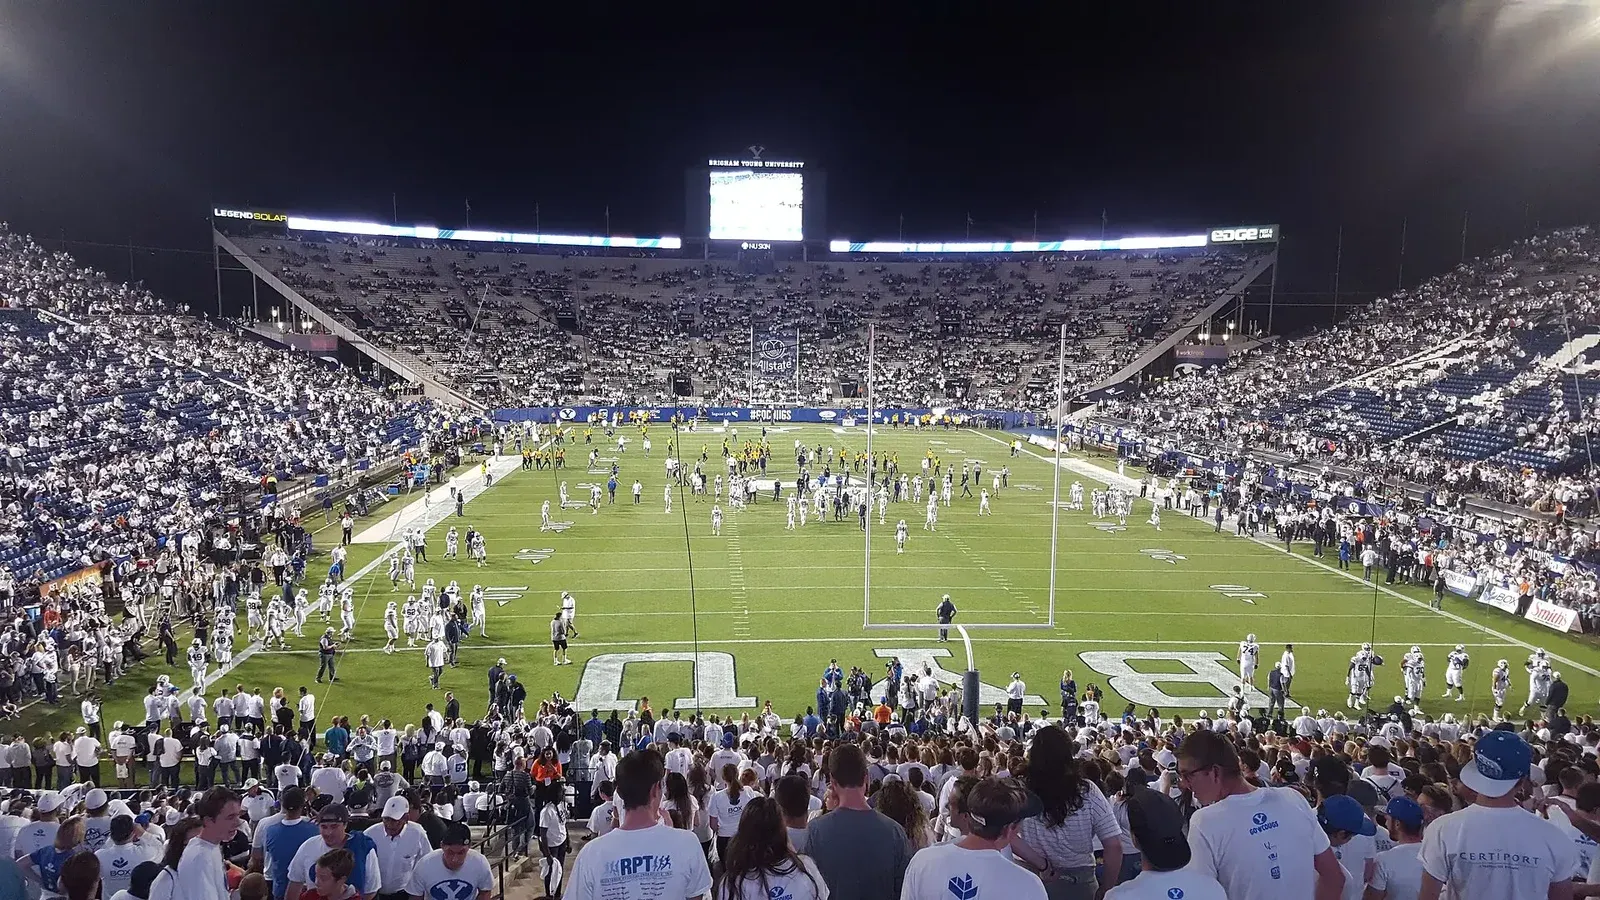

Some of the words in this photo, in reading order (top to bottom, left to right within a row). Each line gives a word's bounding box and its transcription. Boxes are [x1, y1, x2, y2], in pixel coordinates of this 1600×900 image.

[756, 359, 792, 371] Allstate
[1495, 592, 1517, 606] BOX
[1242, 646, 1254, 656] 74
[1459, 852, 1541, 865] CERTIPORT
[620, 855, 654, 876] RPT
[110, 869, 131, 877] BOX
